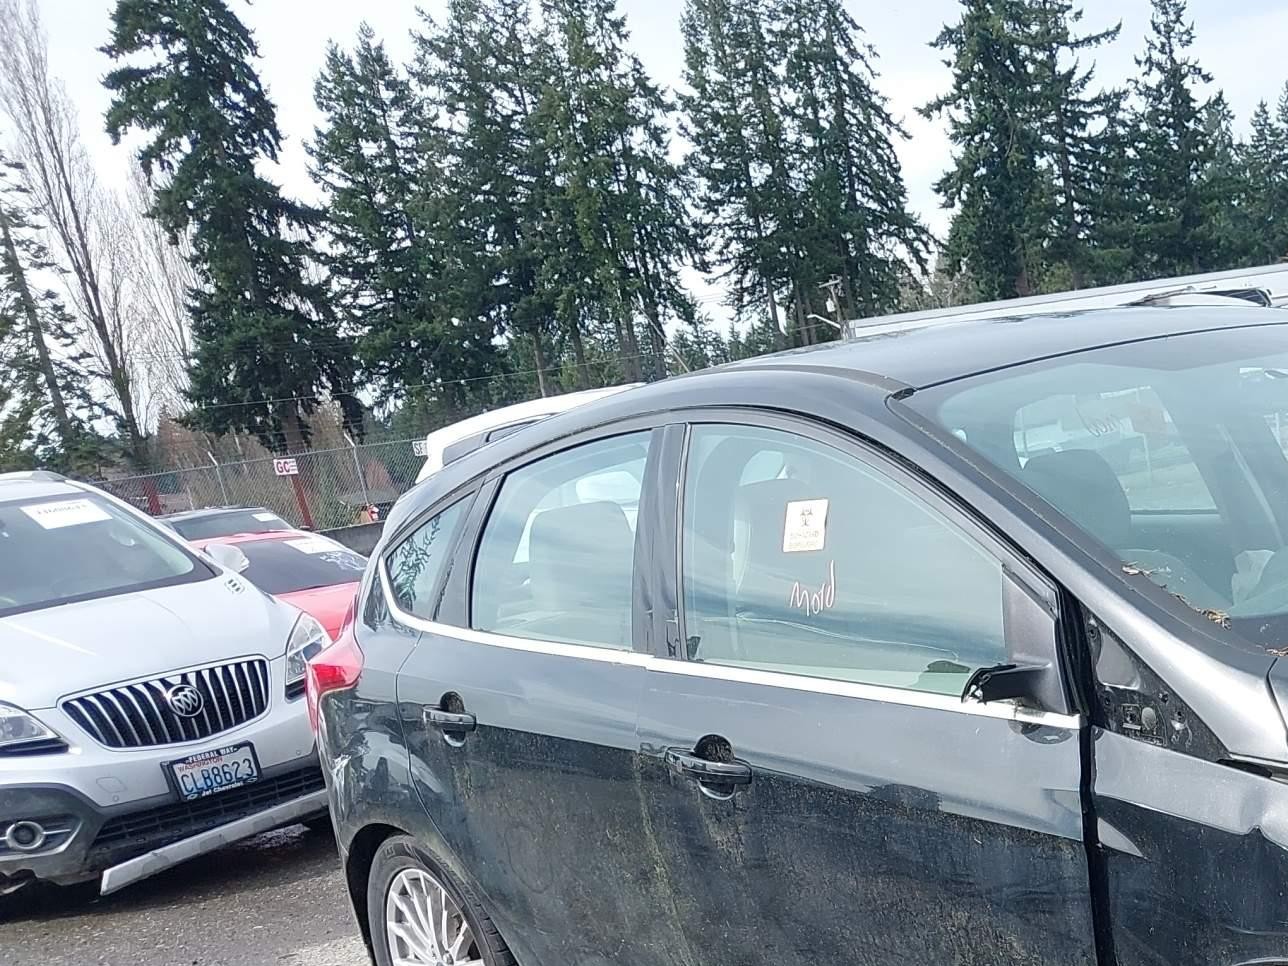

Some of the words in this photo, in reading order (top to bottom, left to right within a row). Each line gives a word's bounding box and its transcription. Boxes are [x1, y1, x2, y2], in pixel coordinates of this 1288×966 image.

[276, 460, 290, 473] GC
[188, 749, 218, 764] FEDERAL
[219, 745, 234, 756] WAY
[181, 758, 253, 793] CLB8623
